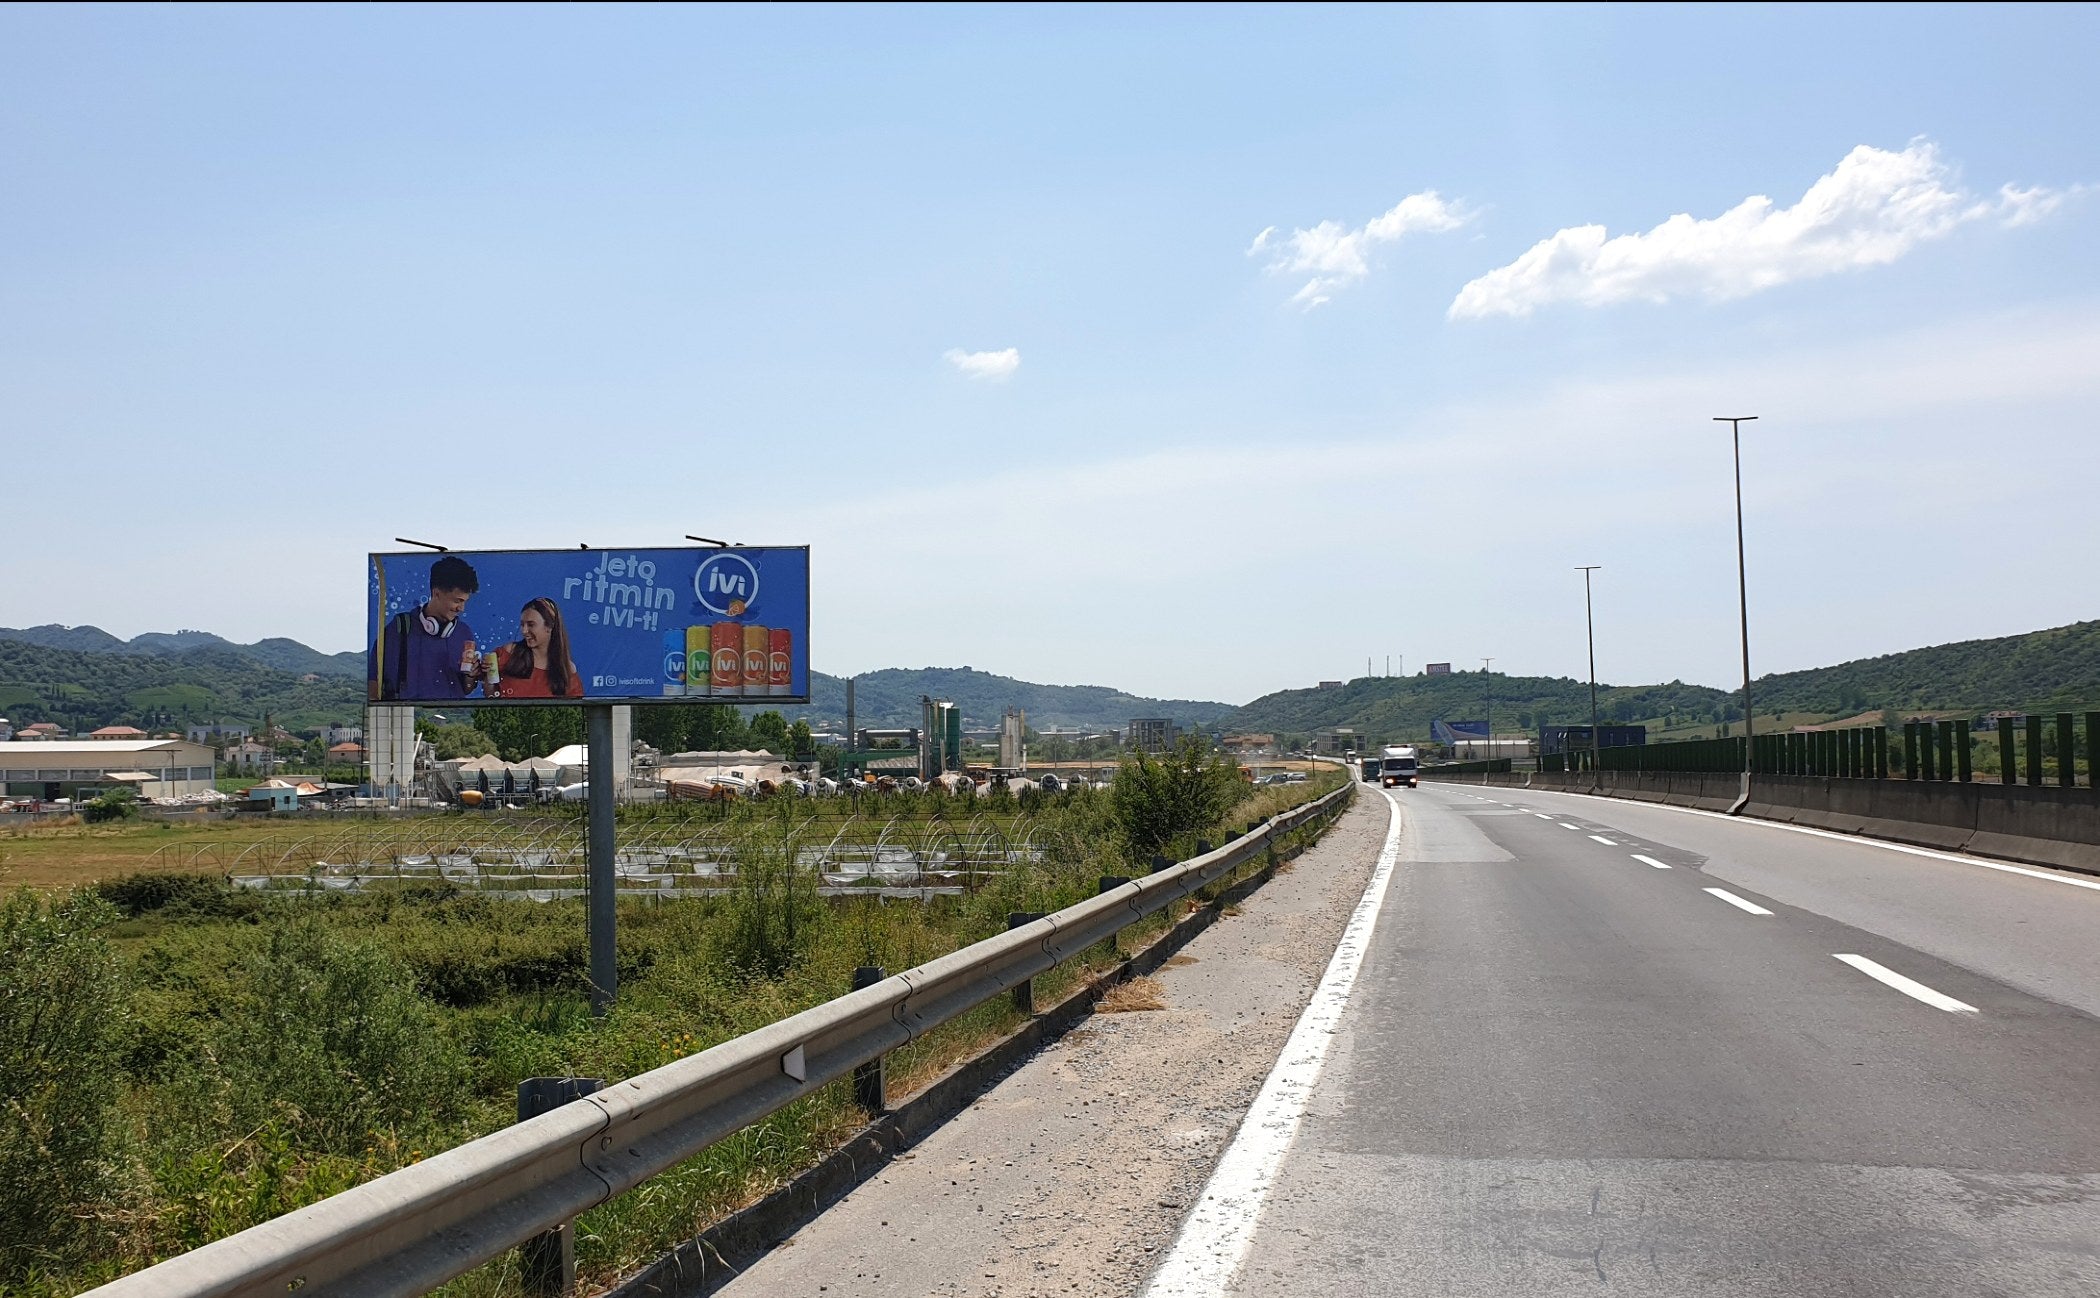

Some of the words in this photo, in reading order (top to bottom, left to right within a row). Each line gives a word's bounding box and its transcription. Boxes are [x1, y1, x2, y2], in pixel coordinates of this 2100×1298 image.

[593, 551, 656, 580] Jeto
[563, 572, 675, 611] ritmin
[588, 612, 600, 624] e
[602, 606, 659, 632] IVI-t!
